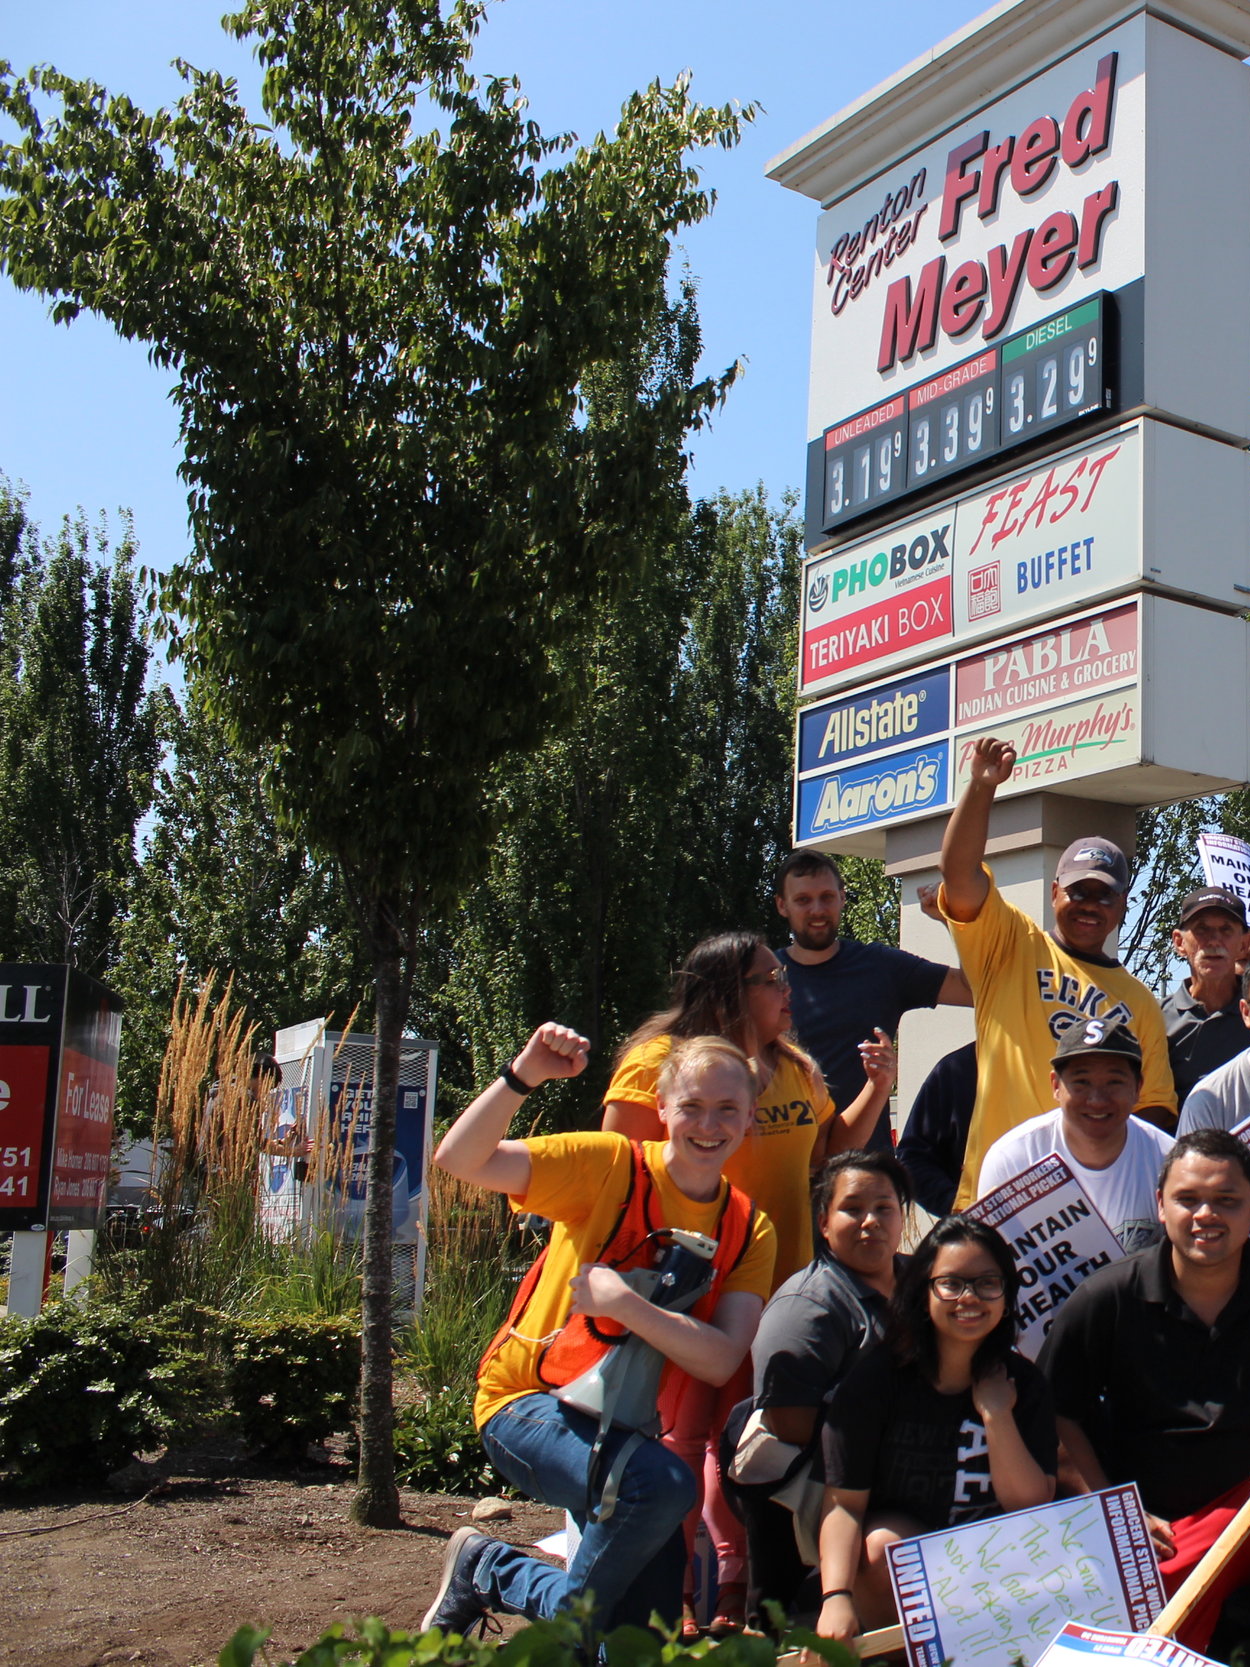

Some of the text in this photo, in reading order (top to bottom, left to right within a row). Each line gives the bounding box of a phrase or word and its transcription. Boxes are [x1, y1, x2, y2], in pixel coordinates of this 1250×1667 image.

[938, 51, 1119, 242] Fred
[827, 168, 927, 285] Renton
[831, 203, 929, 315] Center
[877, 180, 1119, 374] Meyer
[1025, 319, 1073, 351] DIESEL
[916, 357, 988, 405] MID-GRADE
[834, 403, 895, 445] UNLEADED
[969, 445, 1121, 556] FEAST
[832, 524, 951, 603] PHOBOX
[1017, 536, 1095, 594] BUFFET
[810, 594, 944, 669] TERIYAKI BOX
[983, 618, 1112, 692] PABLA
[958, 650, 1137, 721] INDIAN CUISINE & GROCERY
[1021, 702, 1133, 759] Murphy's
[813, 760, 938, 828] Aaron's
[1013, 755, 1068, 782] PIZZA
[1083, 1020, 1105, 1045] S
[65, 1072, 110, 1124] For Lease
[345, 1100, 372, 1111] YOU
[982, 1168, 1068, 1226] ATIONAL PICKET
[986, 1185, 1015, 1211] STORE
[1012, 1157, 1060, 1193] WORKERS
[1008, 1199, 1091, 1262] INTAIN
[1016, 1241, 1078, 1288] OUR
[1106, 1495, 1151, 1631] INFORMATIONAL PIC
[1121, 1491, 1146, 1546] GROCERY
[1135, 1547, 1156, 1588] STORE
[892, 1543, 936, 1643] UNITED
[1027, 1604, 1057, 1641] We
